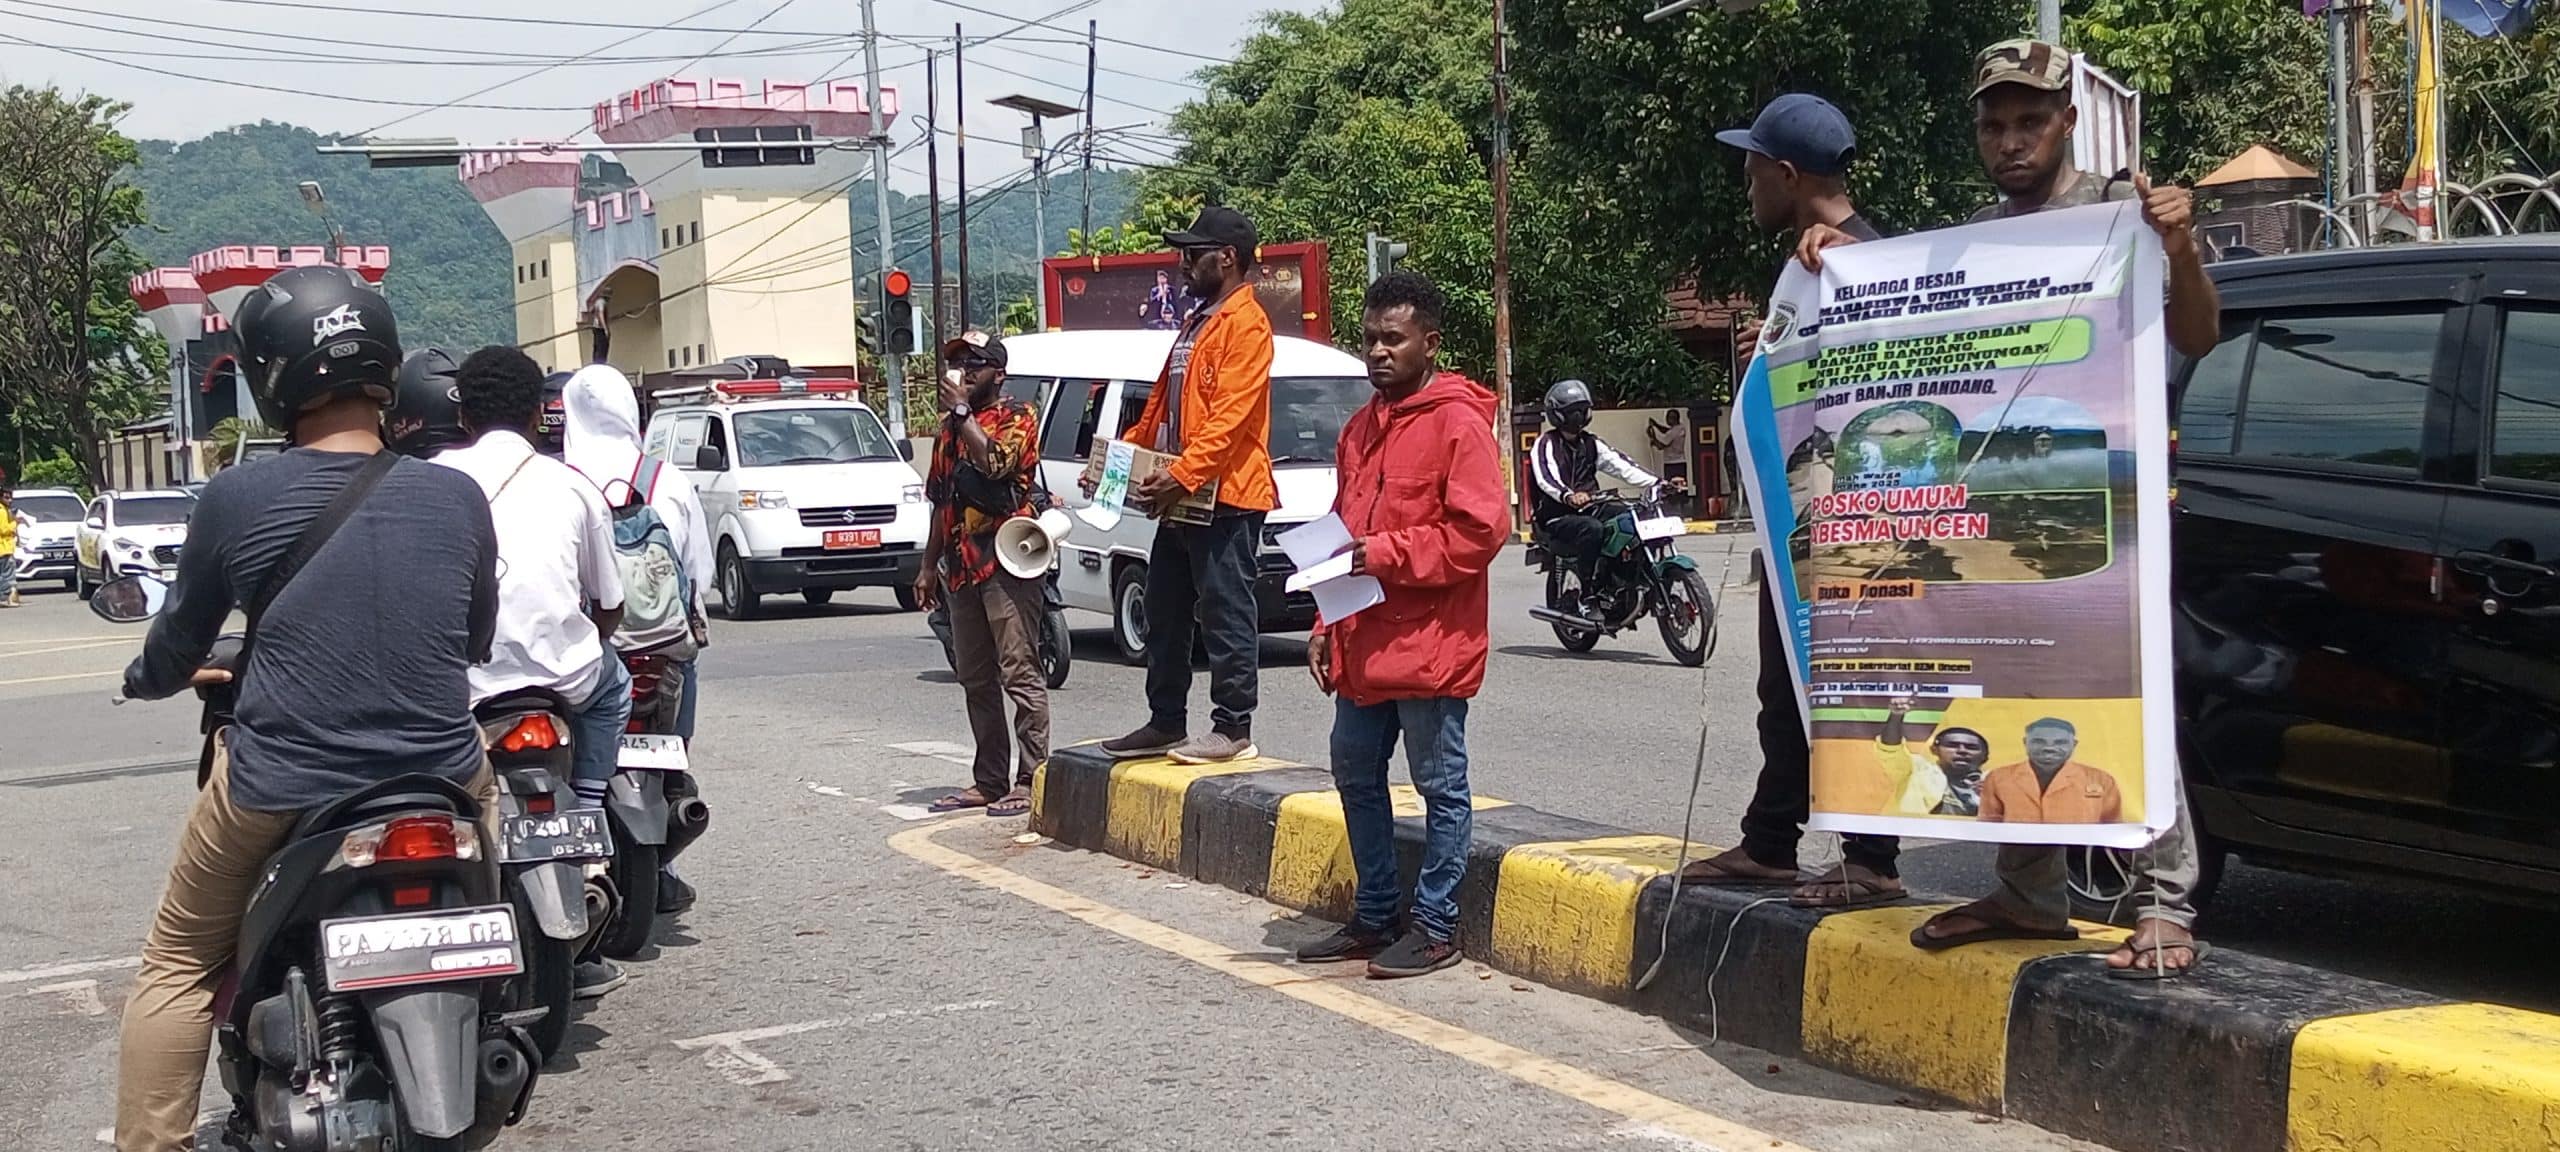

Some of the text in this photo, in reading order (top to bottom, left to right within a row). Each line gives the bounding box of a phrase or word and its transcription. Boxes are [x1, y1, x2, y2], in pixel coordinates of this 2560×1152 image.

[1834, 269, 1966, 303] KELUARGA BESAR
[1926, 277, 2050, 303] UNIVERSITAS
[1977, 289, 2041, 306] TAHUN
[2047, 281, 2094, 297] 2025
[1827, 342, 1879, 357] POSKO
[1885, 334, 1948, 350] UNTUK
[1829, 373, 1873, 387] KOTA
[1875, 359, 1997, 383] JAYAWIJAYA
[1845, 360, 1900, 374] PAPUA
[1855, 382, 1912, 402] BANJIR
[1811, 484, 1967, 517] POSKO UMUM
[1896, 514, 1988, 541] UNCEN
[338, 932, 373, 957] PA
